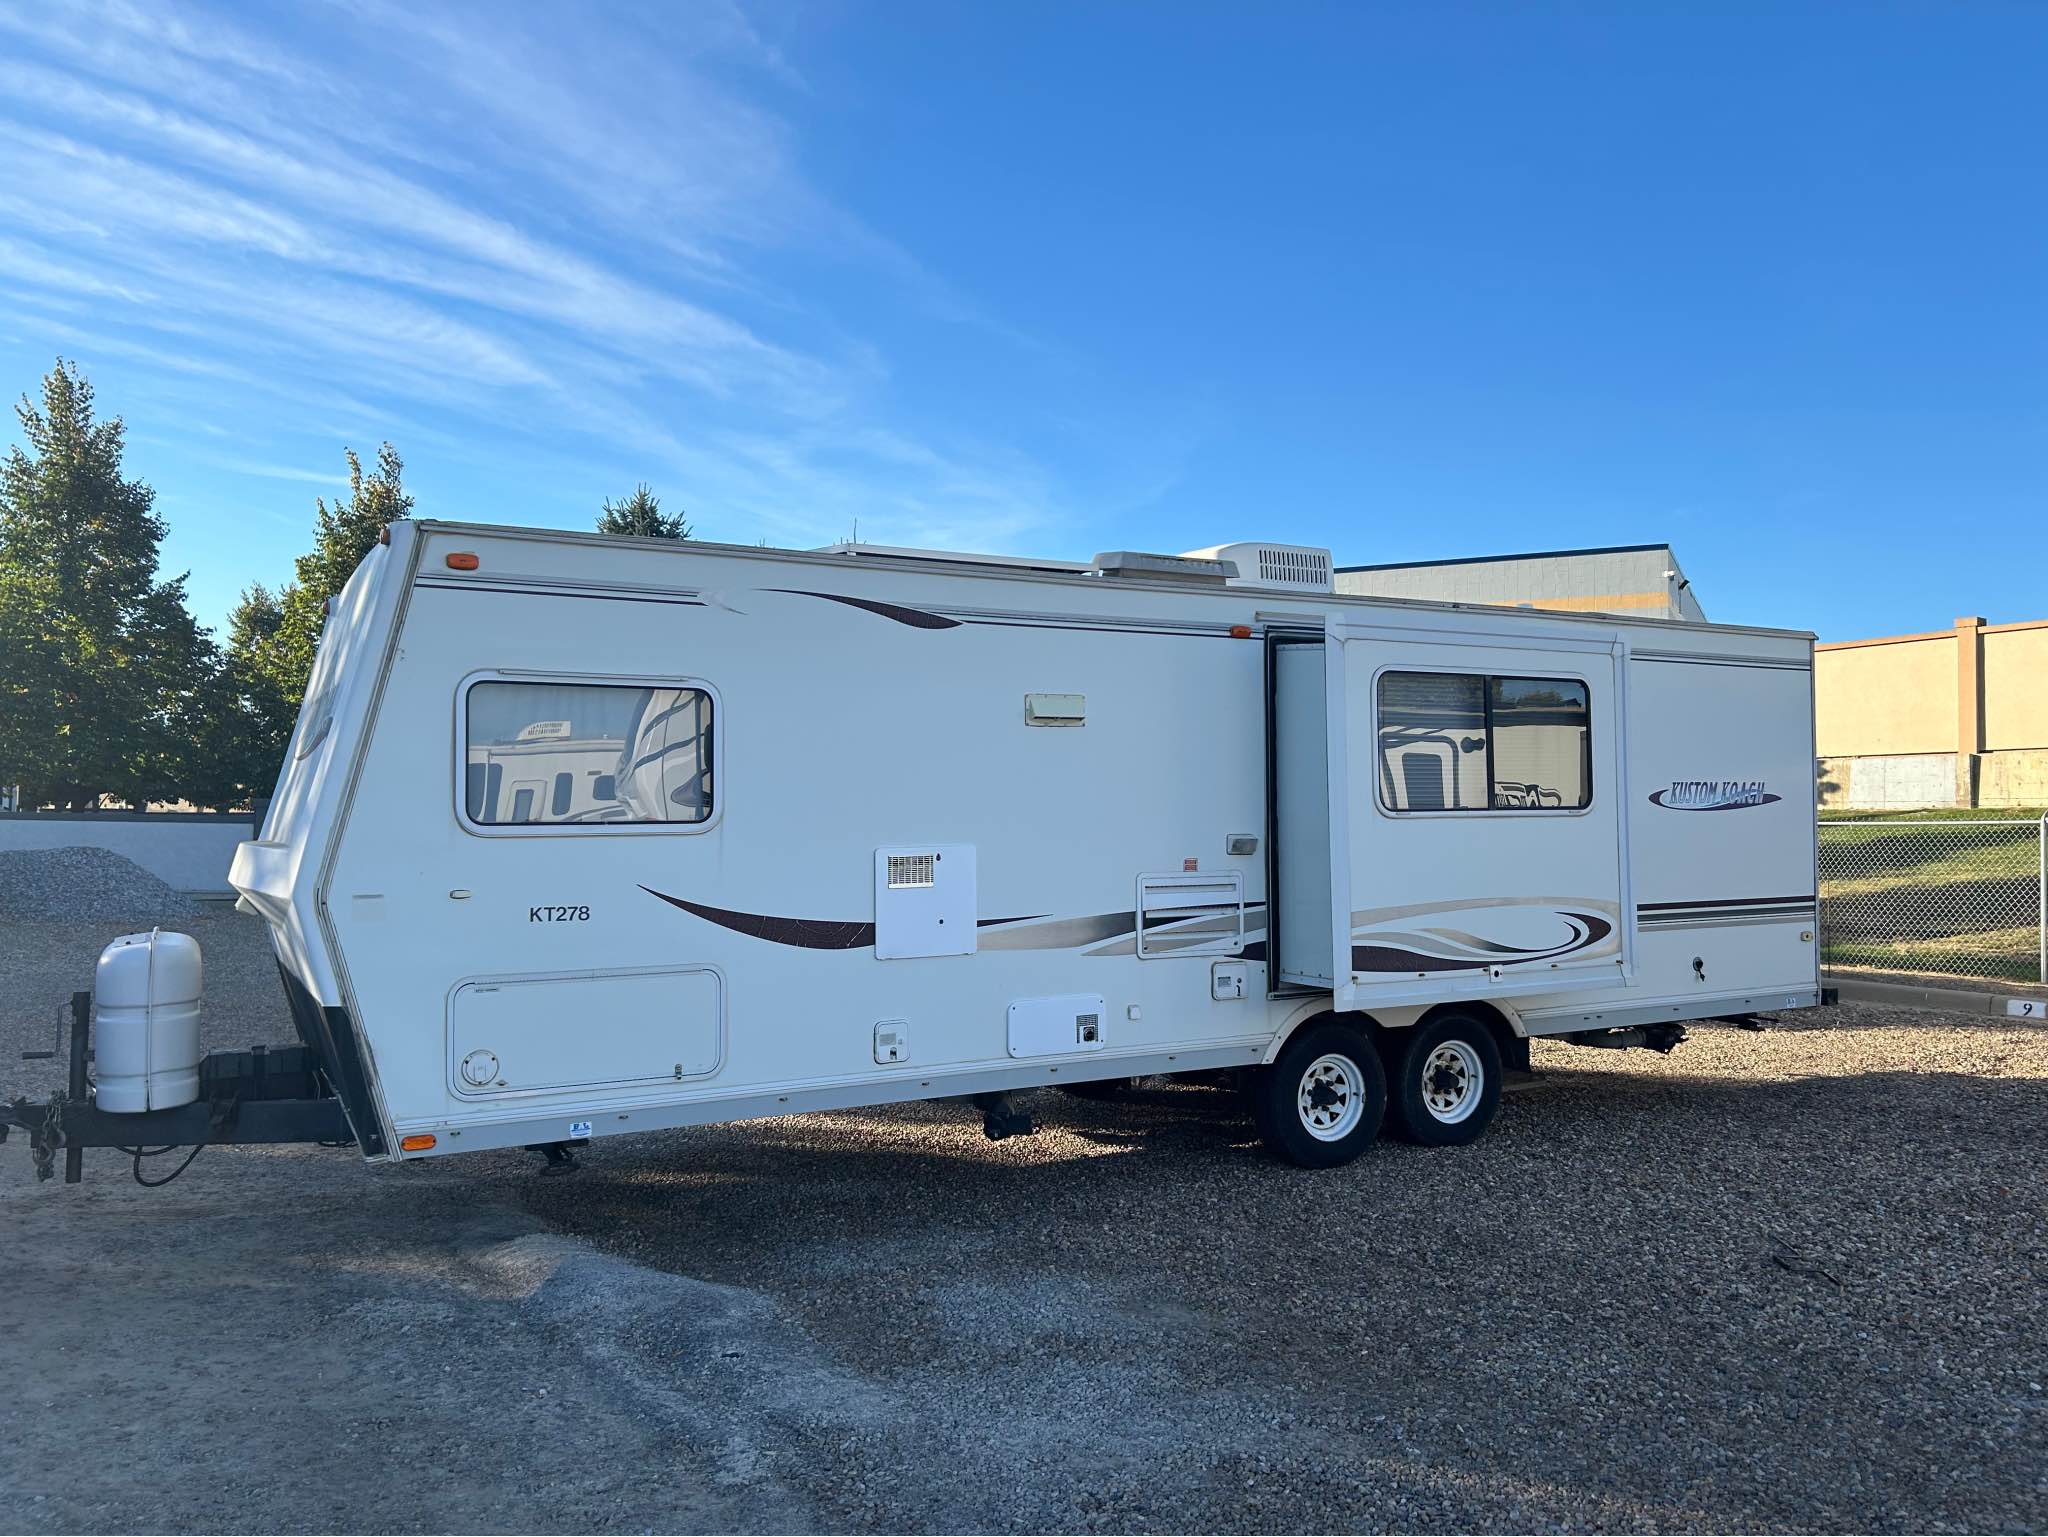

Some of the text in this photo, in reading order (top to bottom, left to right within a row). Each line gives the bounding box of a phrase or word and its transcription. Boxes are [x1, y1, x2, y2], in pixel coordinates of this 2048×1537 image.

[1669, 781, 1766, 804] KUSTOM KOACH
[529, 905, 590, 922] KT278
[2023, 1003, 2033, 1016] 9
